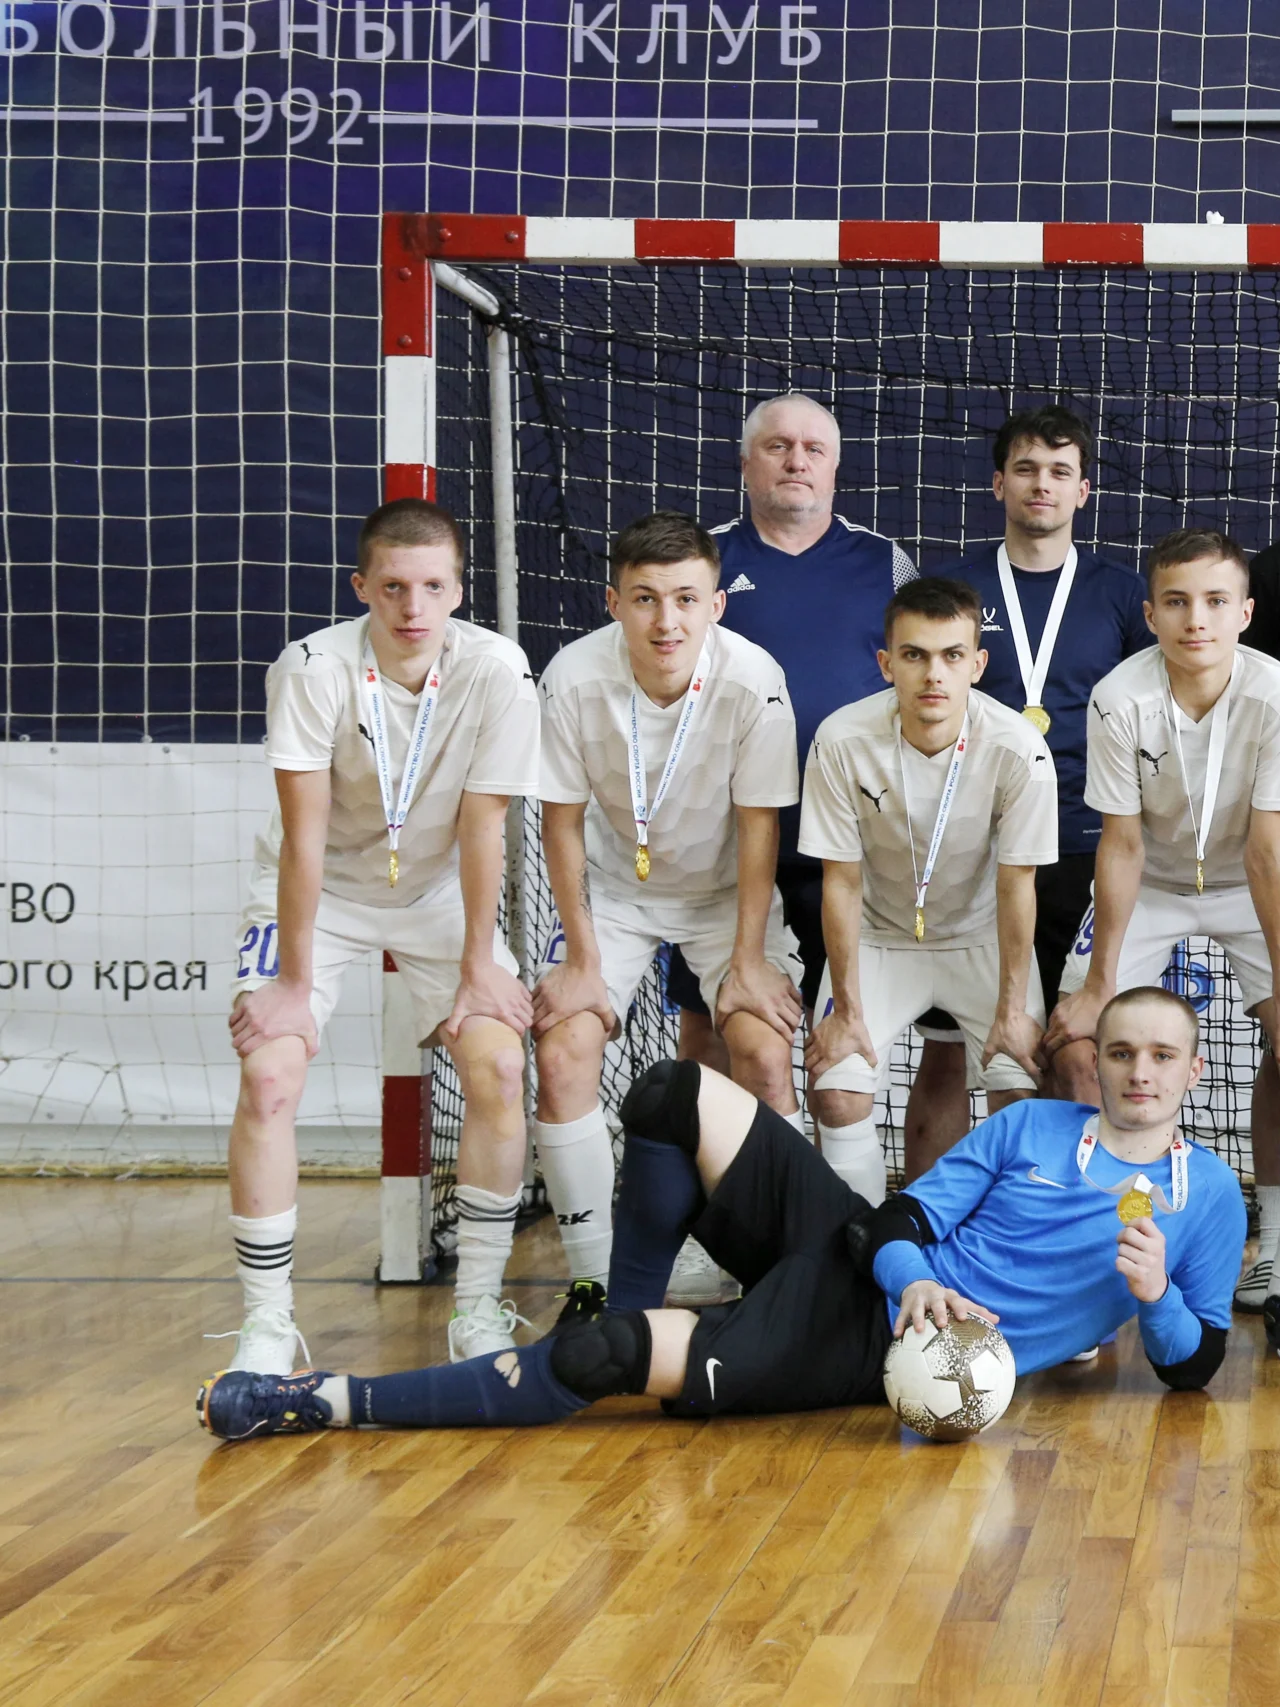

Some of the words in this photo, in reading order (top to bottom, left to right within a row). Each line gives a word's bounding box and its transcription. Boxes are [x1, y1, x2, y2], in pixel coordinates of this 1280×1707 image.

[573, 3, 822, 66] КЛУБ
[188, 87, 364, 145] 1992
[727, 584, 755, 593] adidas
[372, 693, 384, 745] МИНИСТЕРСТВО
[379, 746, 387, 772] СПОРТА
[403, 752, 420, 803] МИНИСТЕРСТВО
[415, 728, 427, 752] СПОРТА
[421, 697, 433, 726] РОССИИ
[657, 751, 678, 801] МИНИСТЕРСТВО
[675, 727, 686, 752] СПОРТА
[682, 701, 695, 727] РОССИИ
[949, 761, 959, 788] РОССИИ
[95, 960, 207, 1002] края
